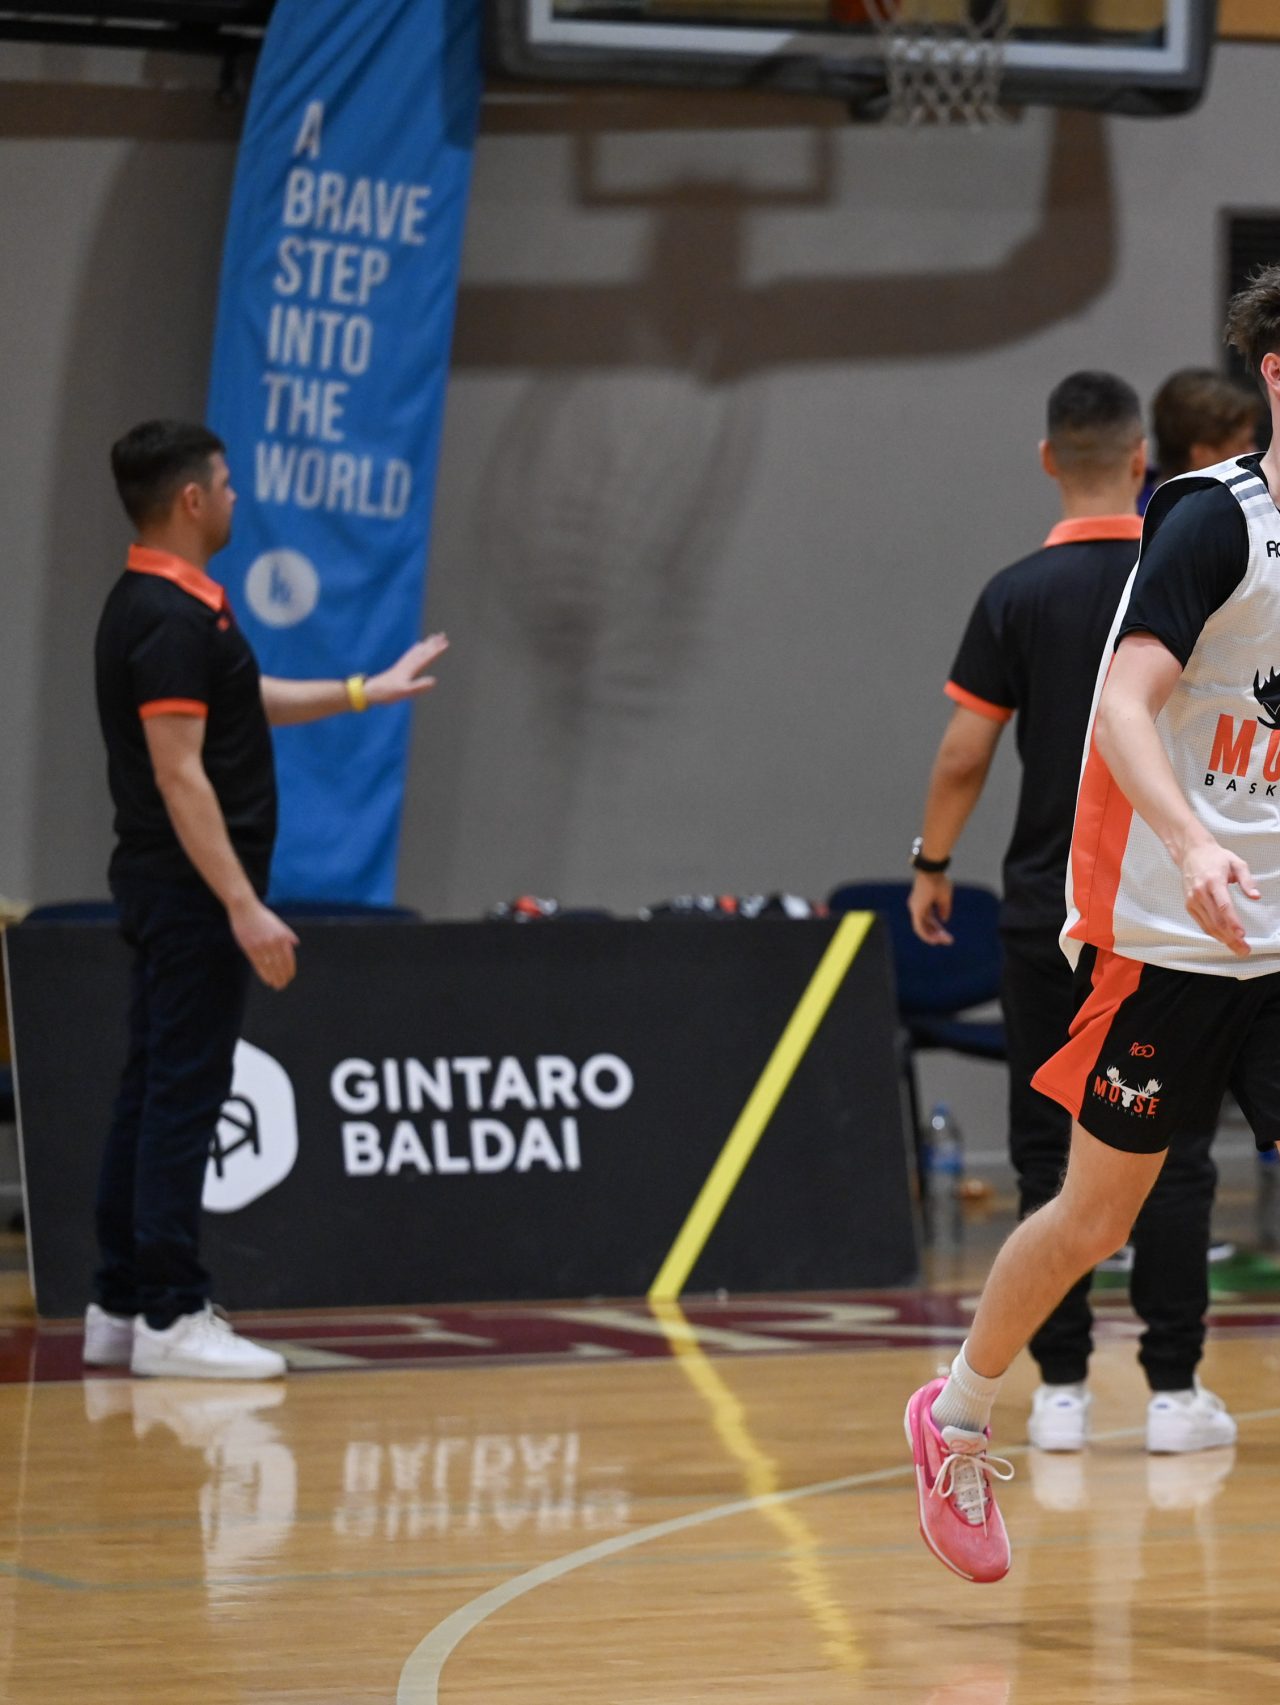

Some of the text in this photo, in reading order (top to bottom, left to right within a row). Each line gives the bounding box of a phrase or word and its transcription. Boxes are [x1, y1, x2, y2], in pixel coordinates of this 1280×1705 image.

[295, 103, 323, 159] A
[284, 170, 431, 244] BRAVE
[275, 239, 389, 303] STEP
[268, 306, 372, 374] INTO
[264, 376, 348, 440] THE
[256, 443, 411, 518] WORLD
[331, 1053, 633, 1112] GINTARO
[1094, 1075, 1160, 1115] MOSE
[344, 1118, 581, 1175] BALDAI
